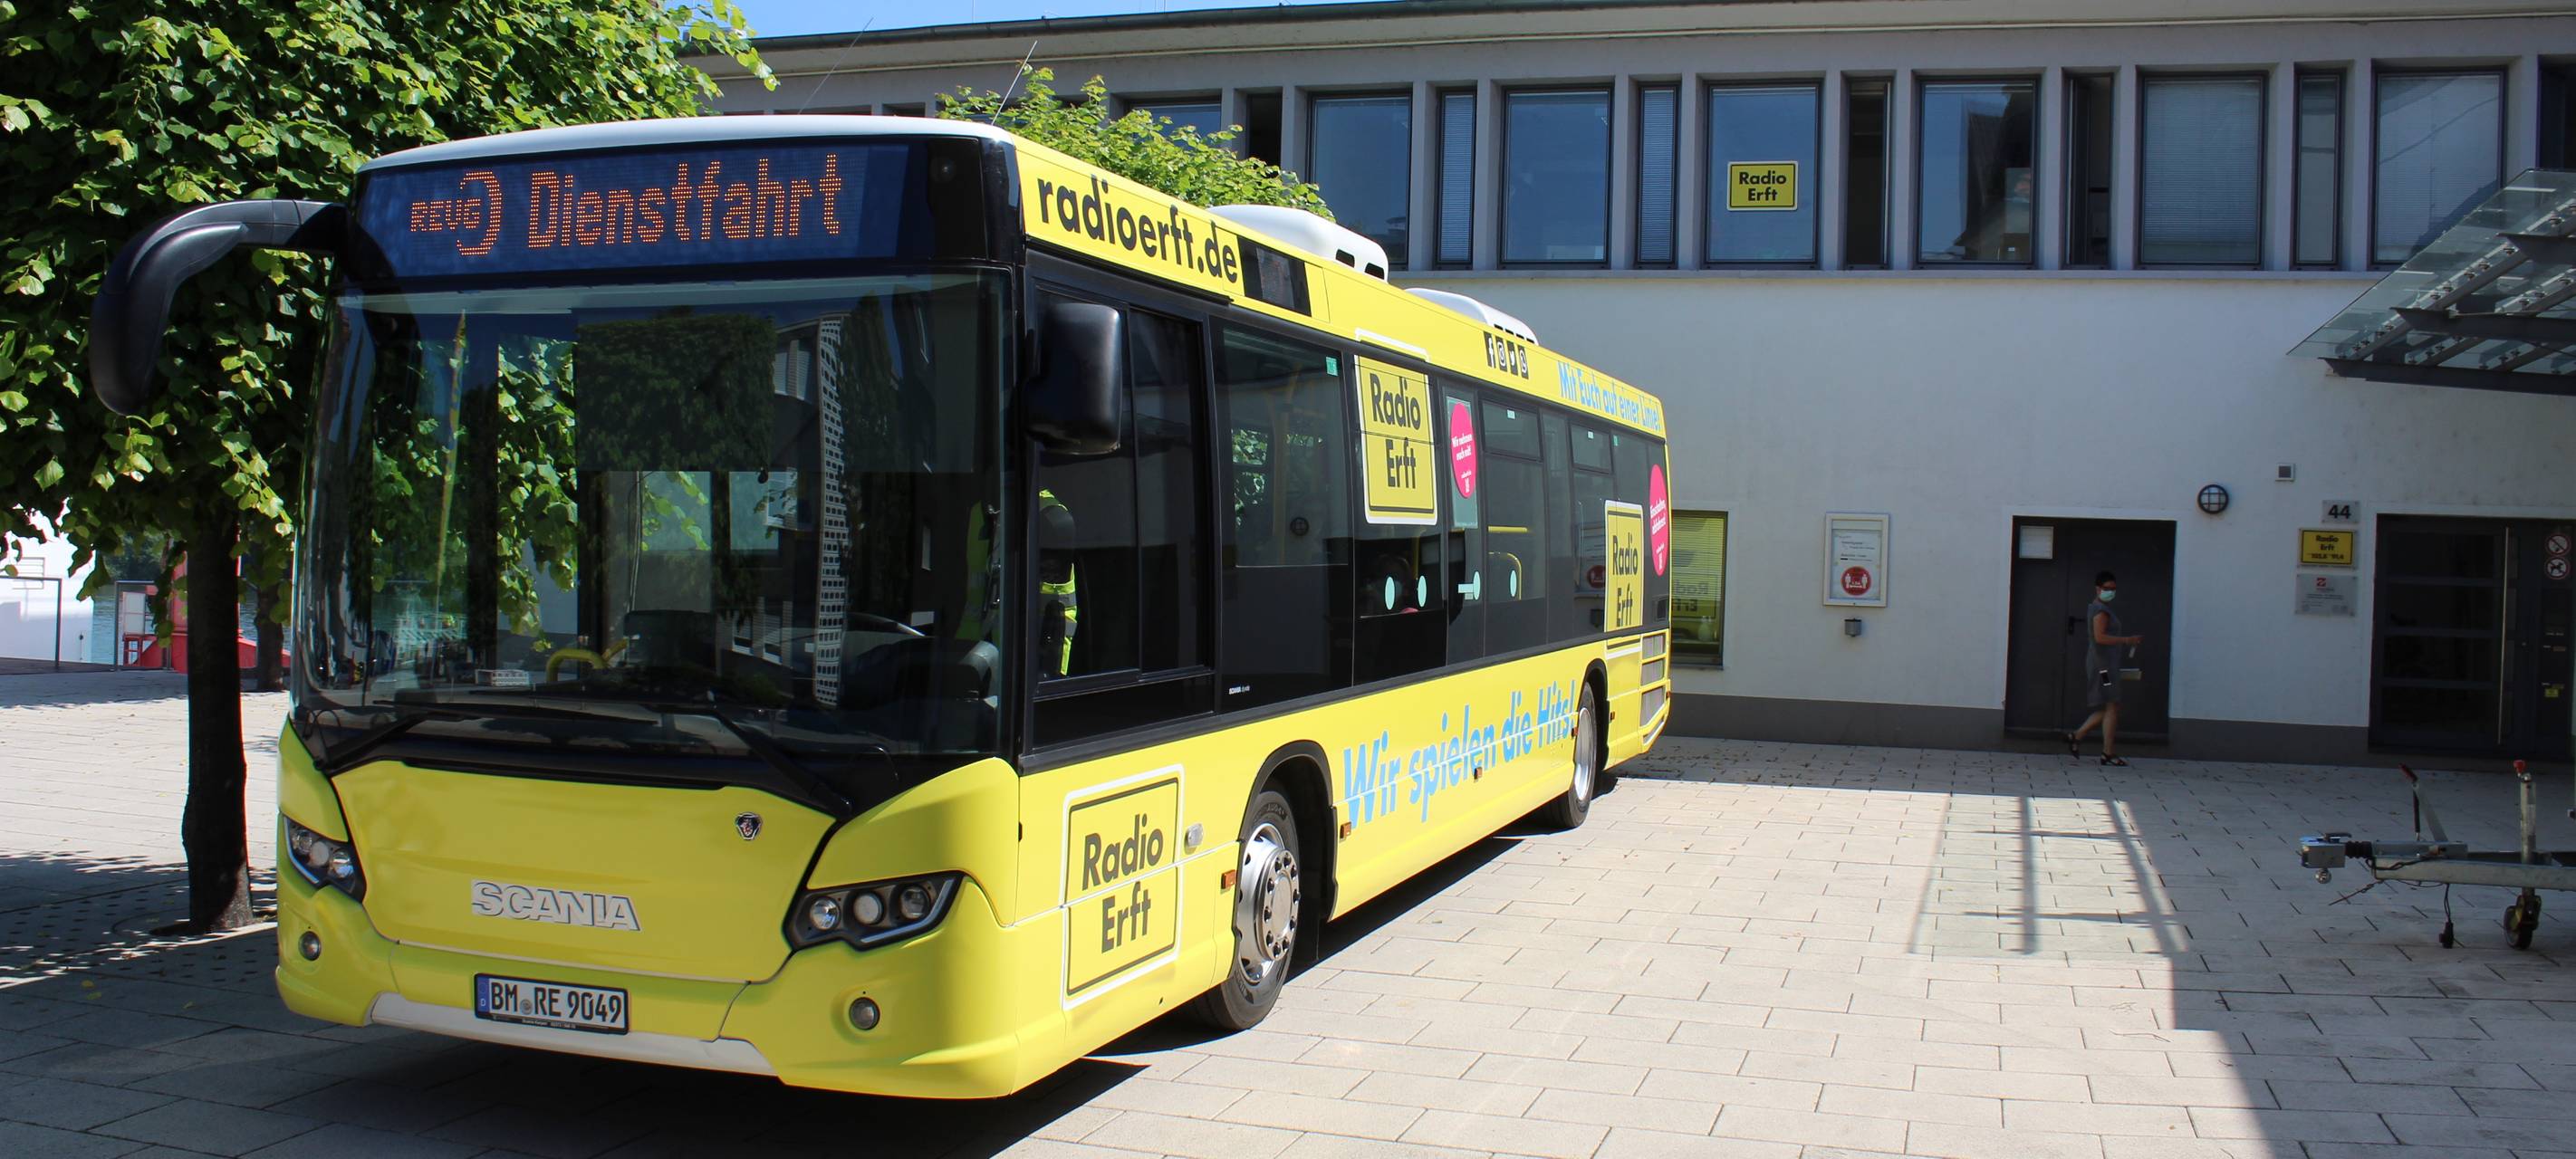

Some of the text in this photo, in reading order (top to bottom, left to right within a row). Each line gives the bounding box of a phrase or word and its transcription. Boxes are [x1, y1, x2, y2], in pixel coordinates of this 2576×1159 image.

[409, 153, 843, 249] REVG Dienstfahrt
[1739, 170, 1787, 185] Radio
[1748, 187, 1778, 201] Erft
[1037, 173, 1238, 283] radioerft.de
[1370, 372, 1421, 431] Radio
[1558, 360, 1577, 402] Mit
[1578, 367, 1600, 409] Euch
[1603, 378, 1618, 418] auf
[1385, 436, 1417, 489] Erft
[2328, 504, 2351, 519] 44
[1612, 532, 1639, 576] Radio
[2315, 534, 2340, 543] Radio
[1616, 582, 1633, 627] Erft
[1343, 679, 1576, 829] Wir spielen die Hits!
[1081, 812, 1164, 892] Radio
[471, 880, 641, 932] SCANIA
[1101, 881, 1151, 954] Erft
[480, 998, 486, 1007] D
[491, 982, 622, 1023] BM RE 9049
